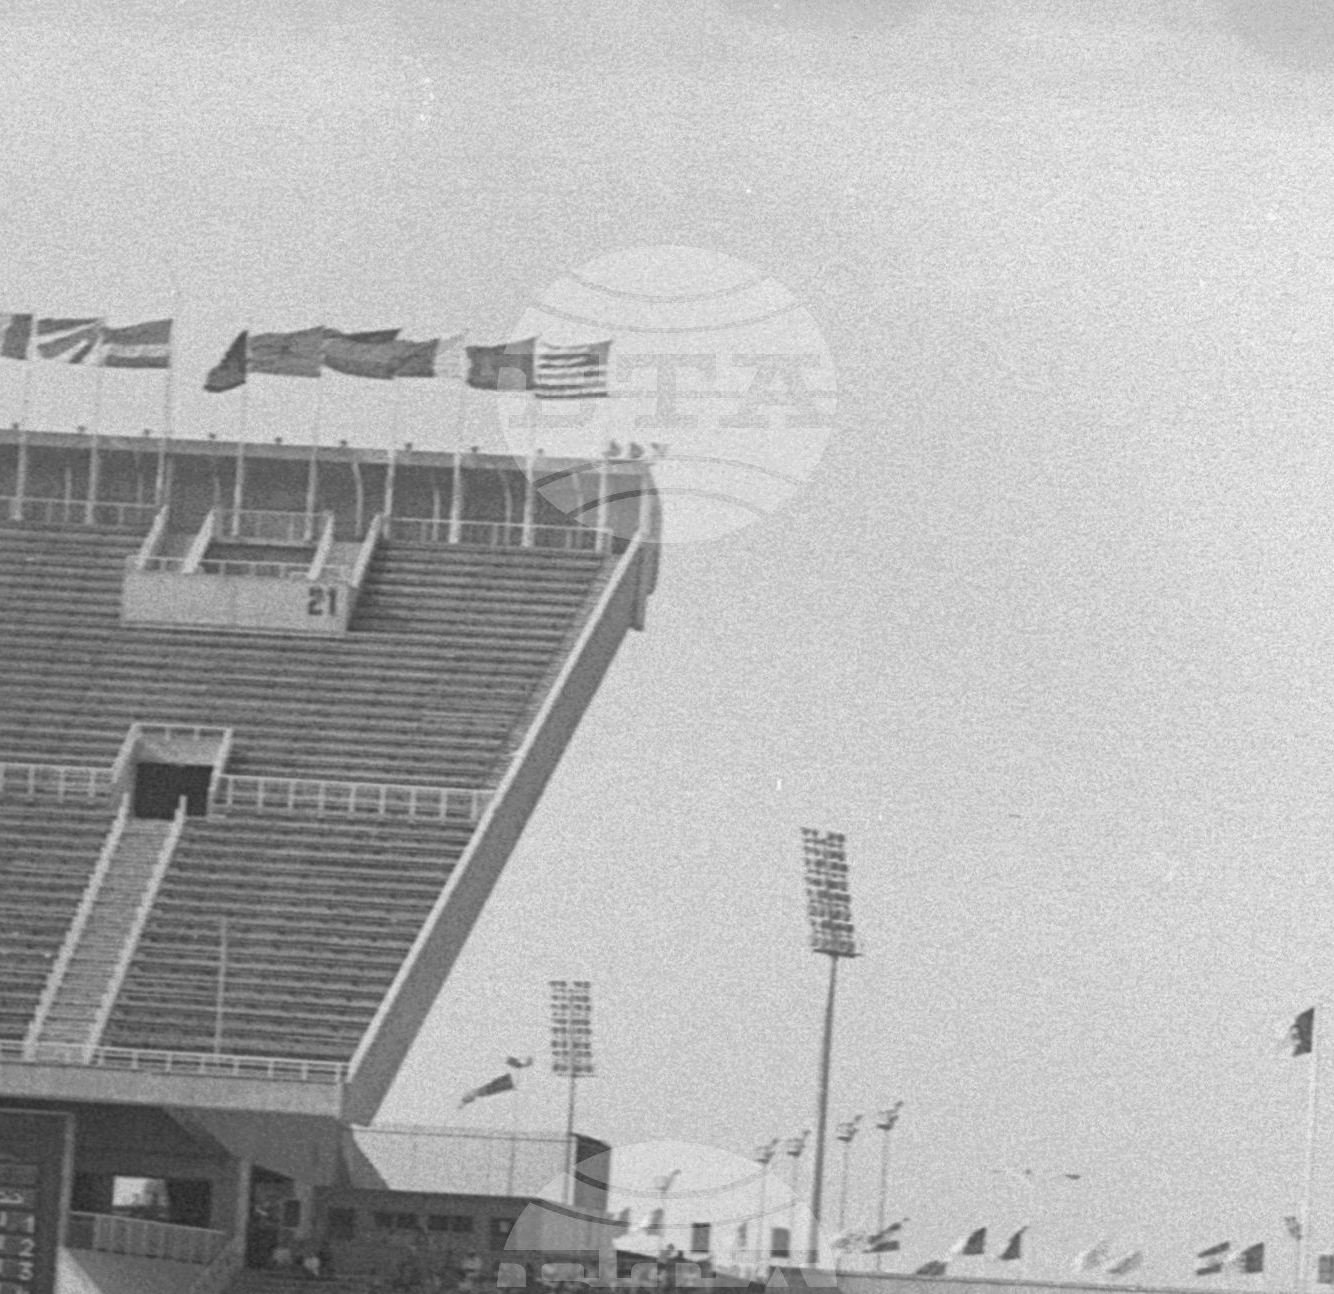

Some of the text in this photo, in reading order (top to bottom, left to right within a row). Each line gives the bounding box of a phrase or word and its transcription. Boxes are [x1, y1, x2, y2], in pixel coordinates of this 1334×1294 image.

[308, 586, 338, 616] 21
[23, 1215, 36, 1233] 1
[18, 1237, 35, 1257] 2
[17, 1260, 34, 1281] 3
